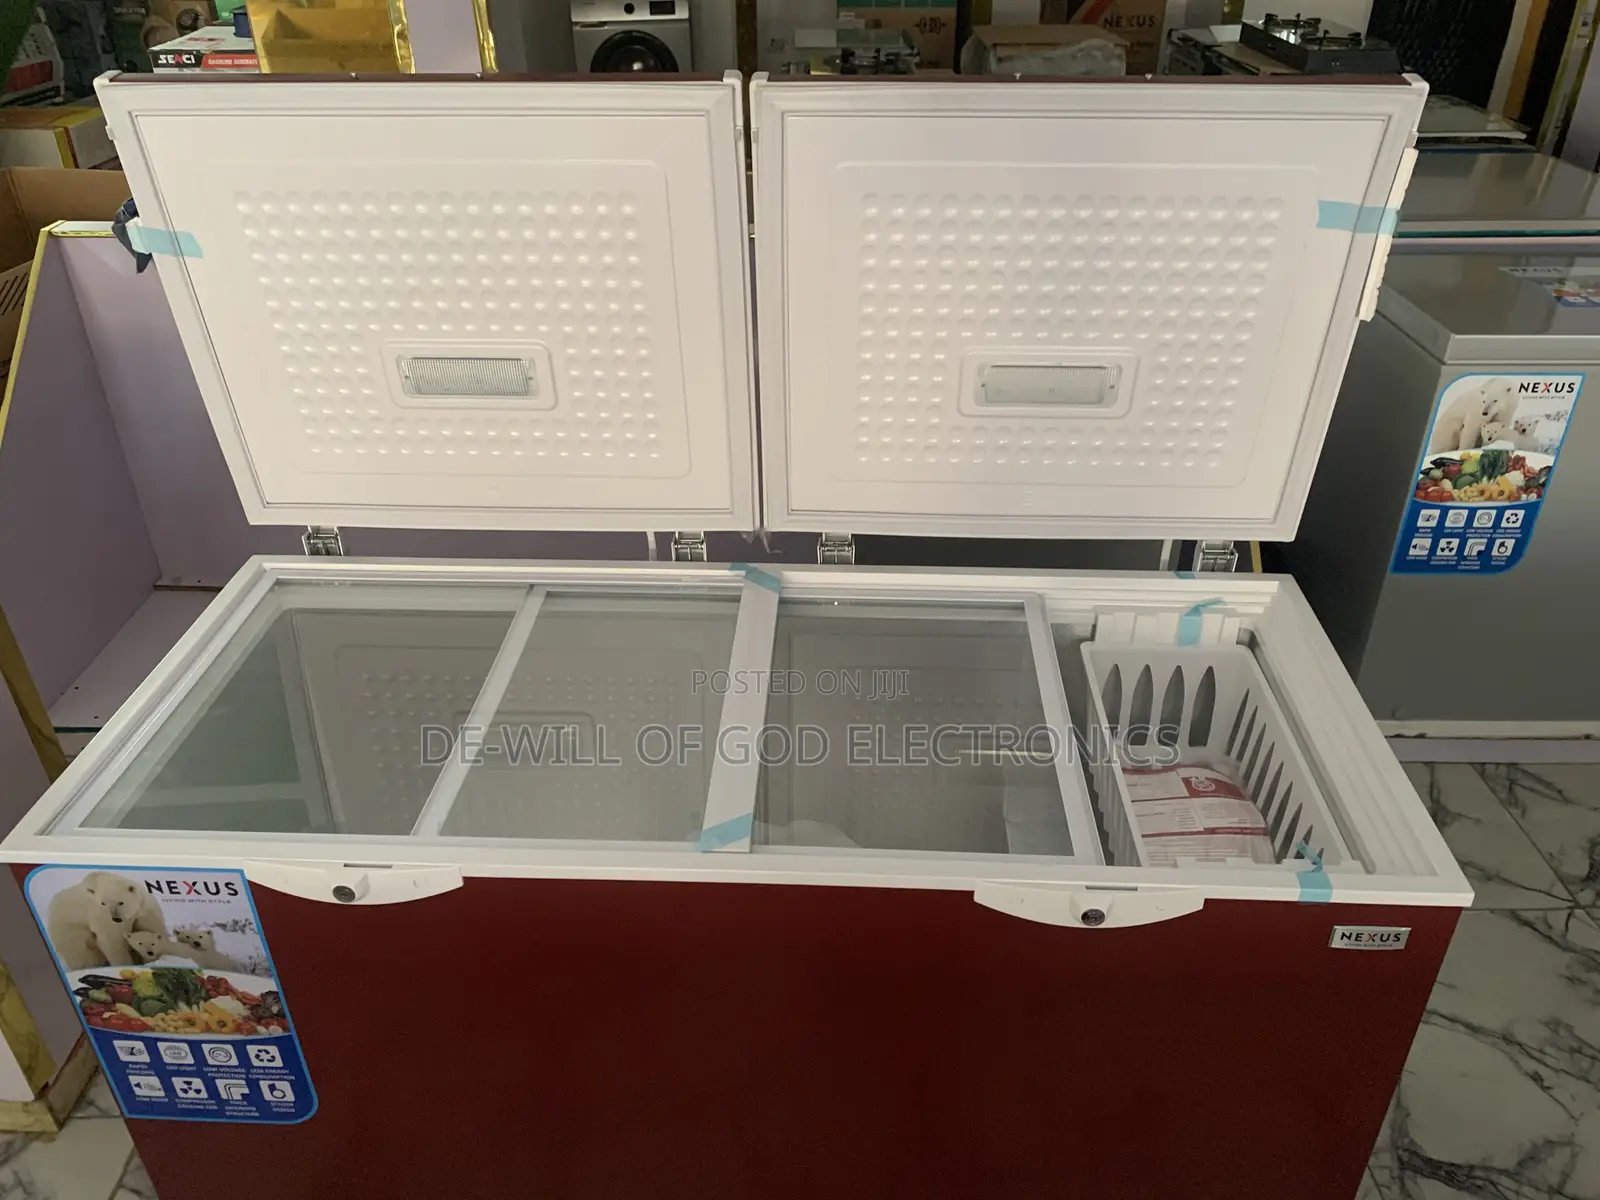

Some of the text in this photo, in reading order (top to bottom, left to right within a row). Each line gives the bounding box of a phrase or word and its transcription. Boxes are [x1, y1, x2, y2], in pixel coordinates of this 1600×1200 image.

[1104, 14, 1156, 29] NEXUS
[158, 53, 195, 65] SENCI
[1518, 382, 1576, 394] NEXUS
[144, 879, 239, 897] NEXUS
[1340, 931, 1402, 942] NEXUS
